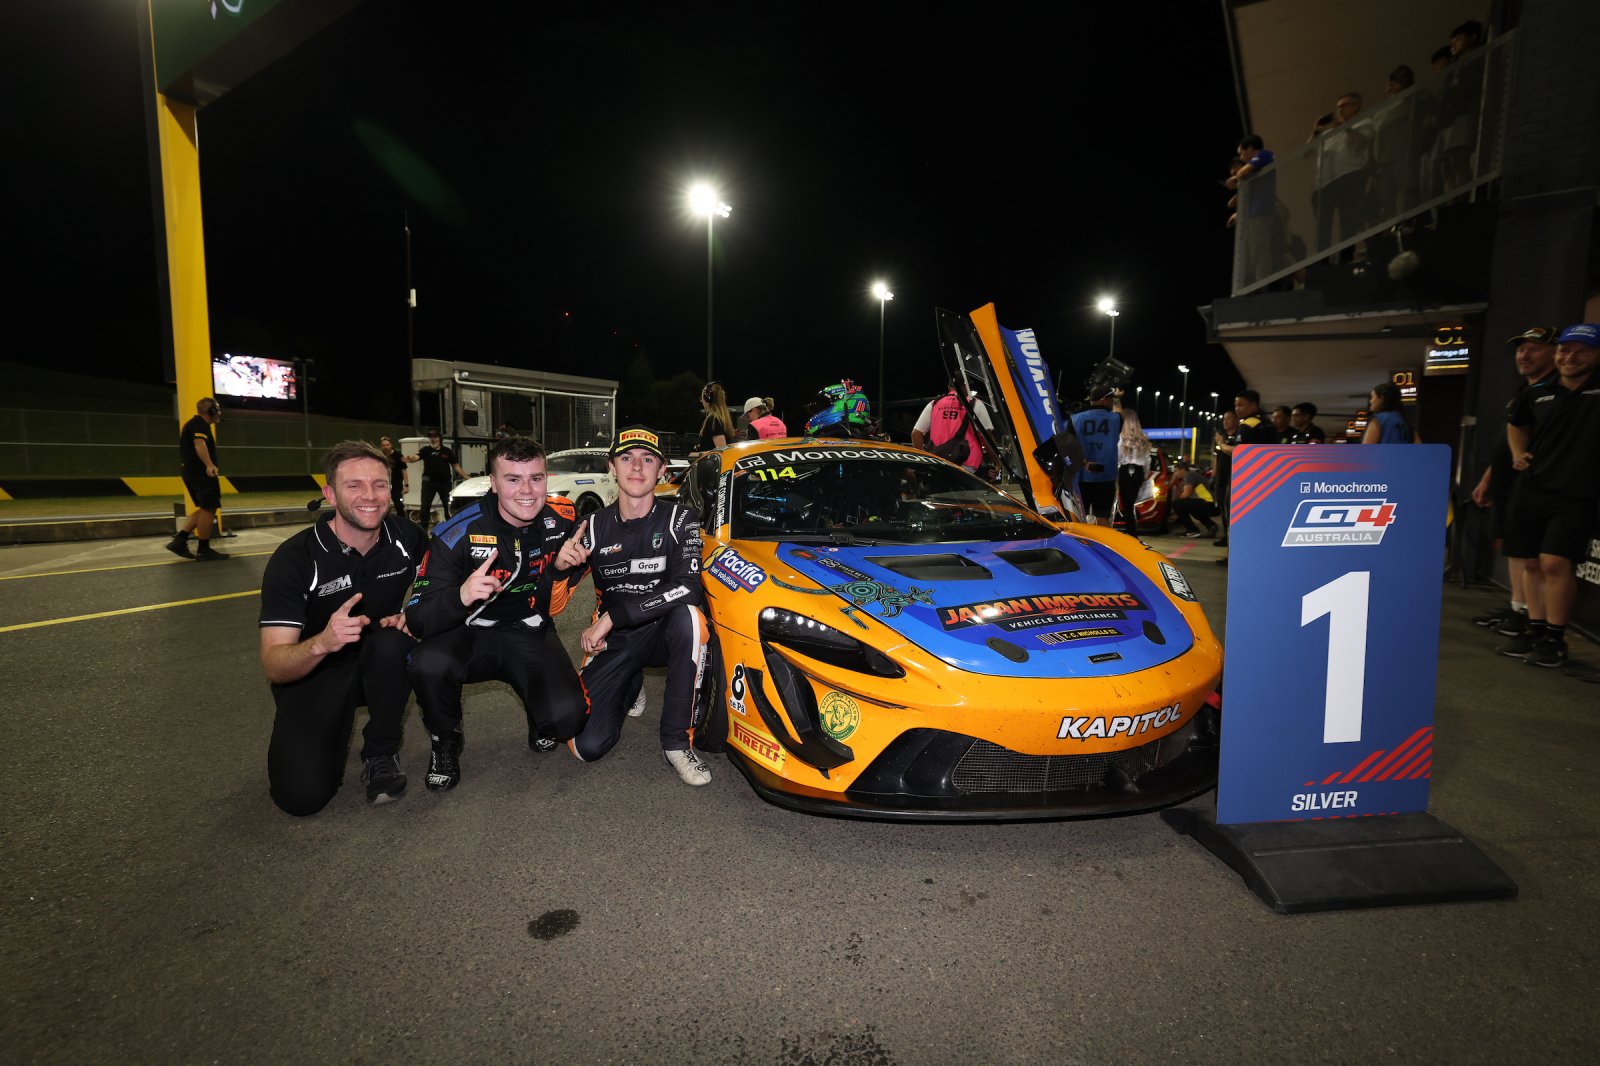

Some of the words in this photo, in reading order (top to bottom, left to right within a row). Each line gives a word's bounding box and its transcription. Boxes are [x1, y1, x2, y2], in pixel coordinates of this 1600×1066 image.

[1083, 419, 1110, 436] 04
[755, 466, 796, 482] 114
[1314, 482, 1388, 493] Monochrome
[1305, 502, 1396, 527] GT4
[1295, 532, 1373, 542] AUSTRALIA
[718, 550, 764, 585] Pacific
[946, 598, 1029, 625] JAPAN
[1031, 594, 1140, 611] IMPORTS
[1009, 617, 1054, 629] VEHICLE
[1057, 612, 1119, 623] COMPLIANCE
[1301, 571, 1370, 743] 1
[1058, 702, 1181, 739] KAPITOL
[733, 720, 780, 762] PIRELLI
[1291, 790, 1358, 812] SILVER
